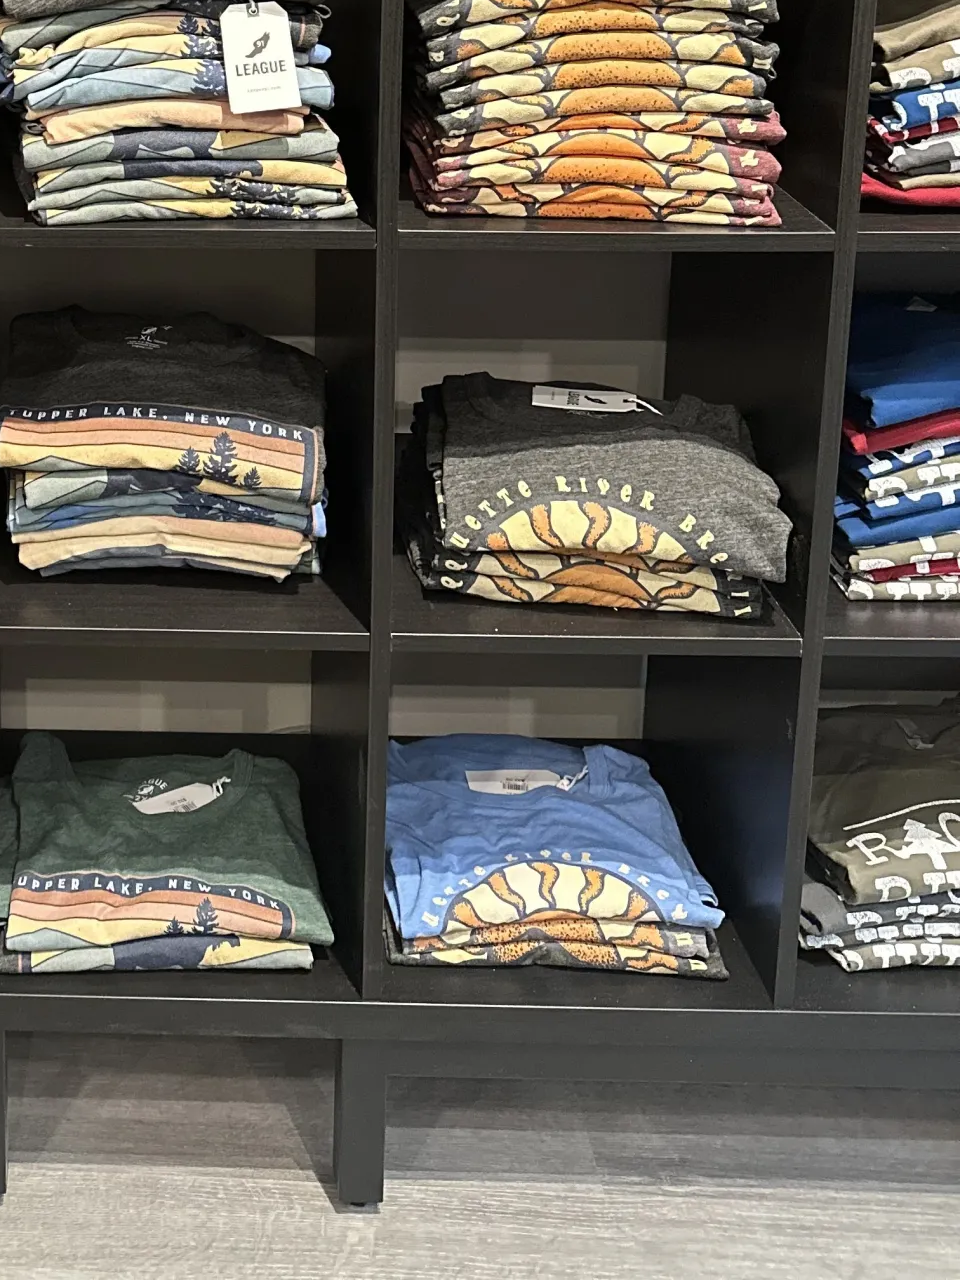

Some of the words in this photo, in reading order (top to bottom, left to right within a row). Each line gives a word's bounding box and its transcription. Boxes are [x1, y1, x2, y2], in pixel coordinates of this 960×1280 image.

[235, 60, 287, 76] LEAGUE
[185, 412, 230, 426] NEW
[248, 420, 304, 441] YORK
[17, 876, 79, 890] UPPER
[168, 878, 211, 893] NEW
[229, 887, 280, 910] YORK
